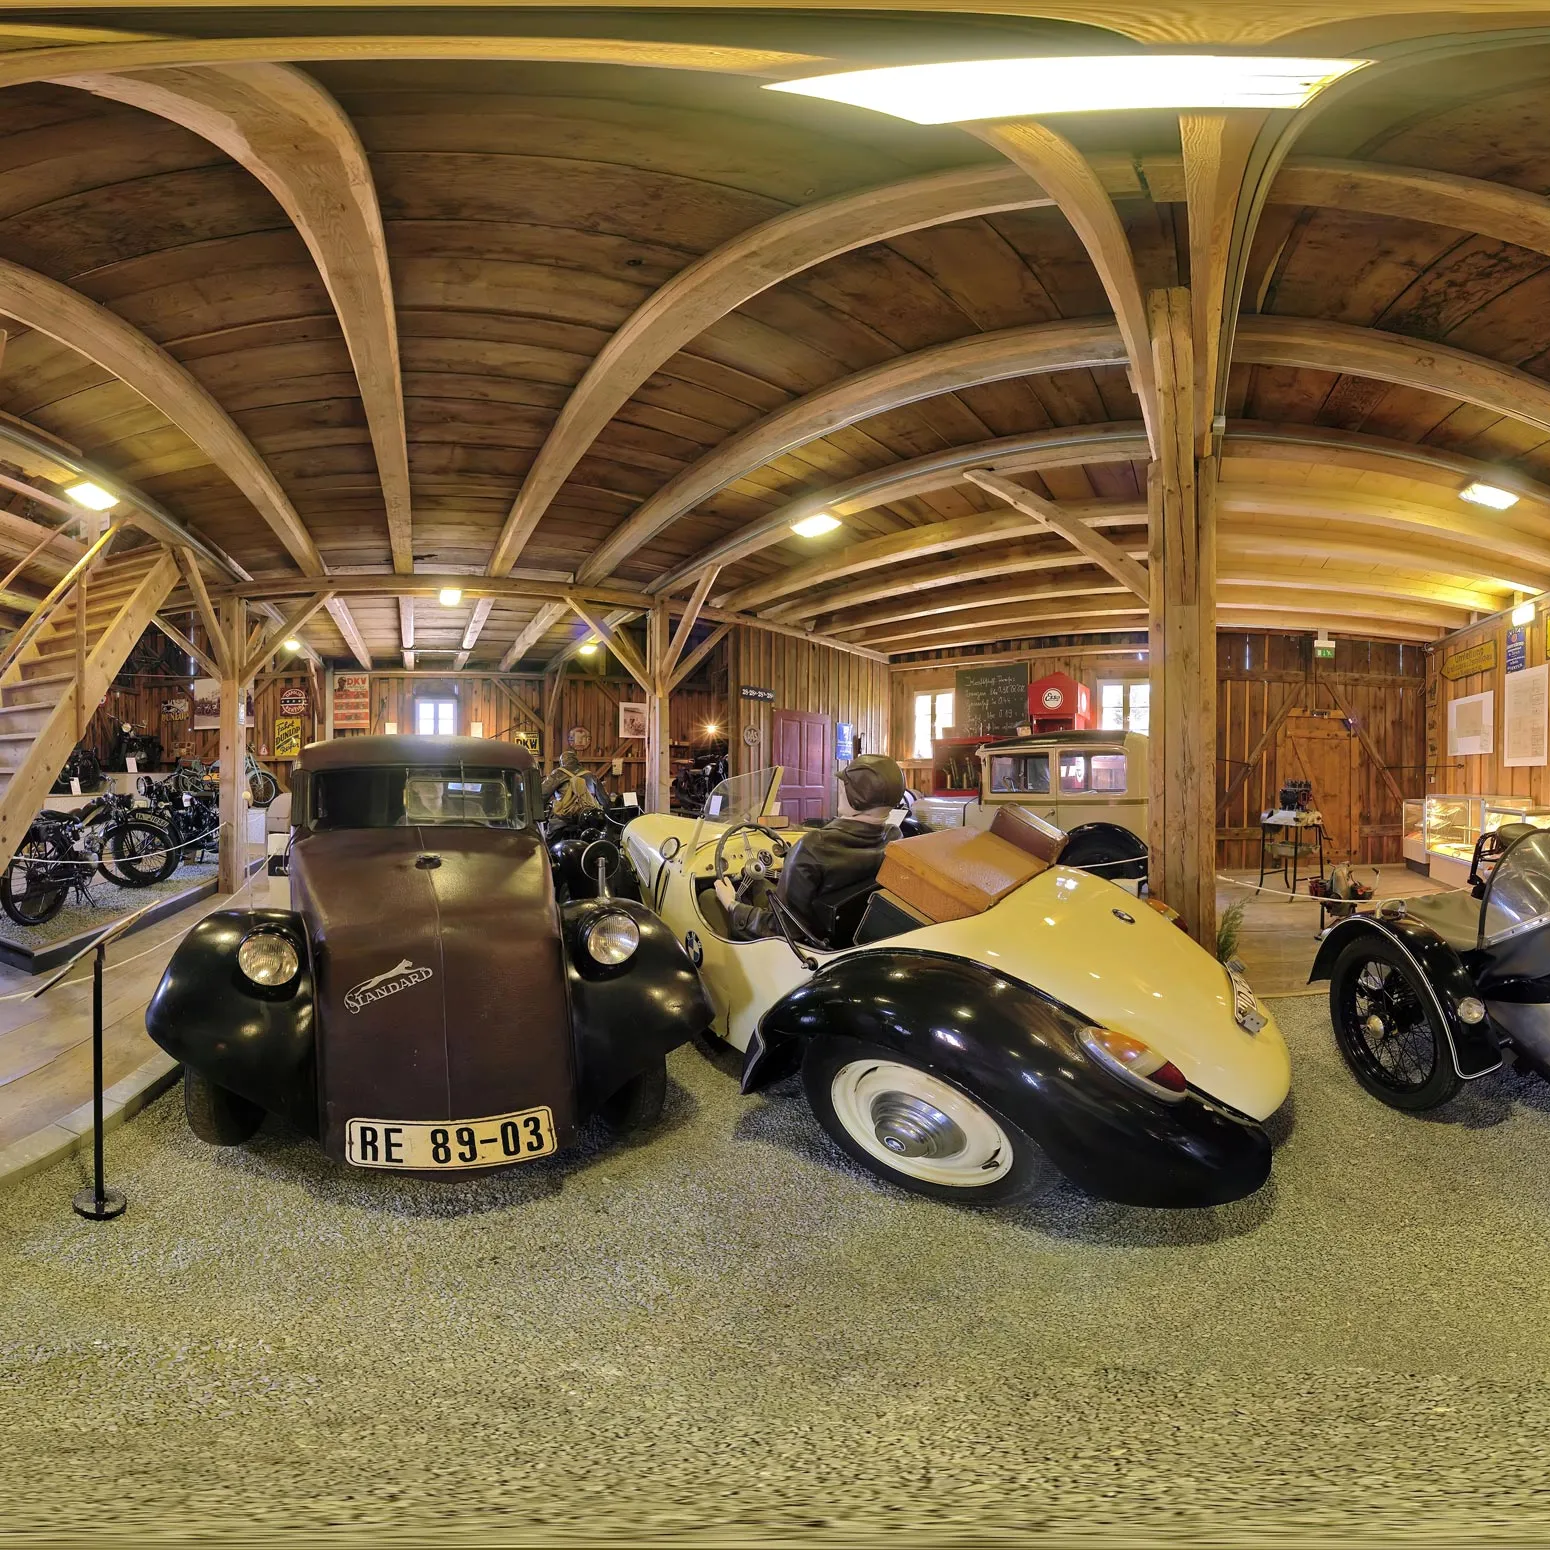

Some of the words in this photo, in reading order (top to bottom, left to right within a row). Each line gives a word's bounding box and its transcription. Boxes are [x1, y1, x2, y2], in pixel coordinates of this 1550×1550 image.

[1045, 692, 1061, 702] Esso
[276, 727, 300, 744] DUNLOP
[277, 722, 295, 735] Fahrt
[344, 967, 433, 1014] STANDARD
[360, 1126, 404, 1164] RE
[430, 1116, 545, 1164] 89-03
